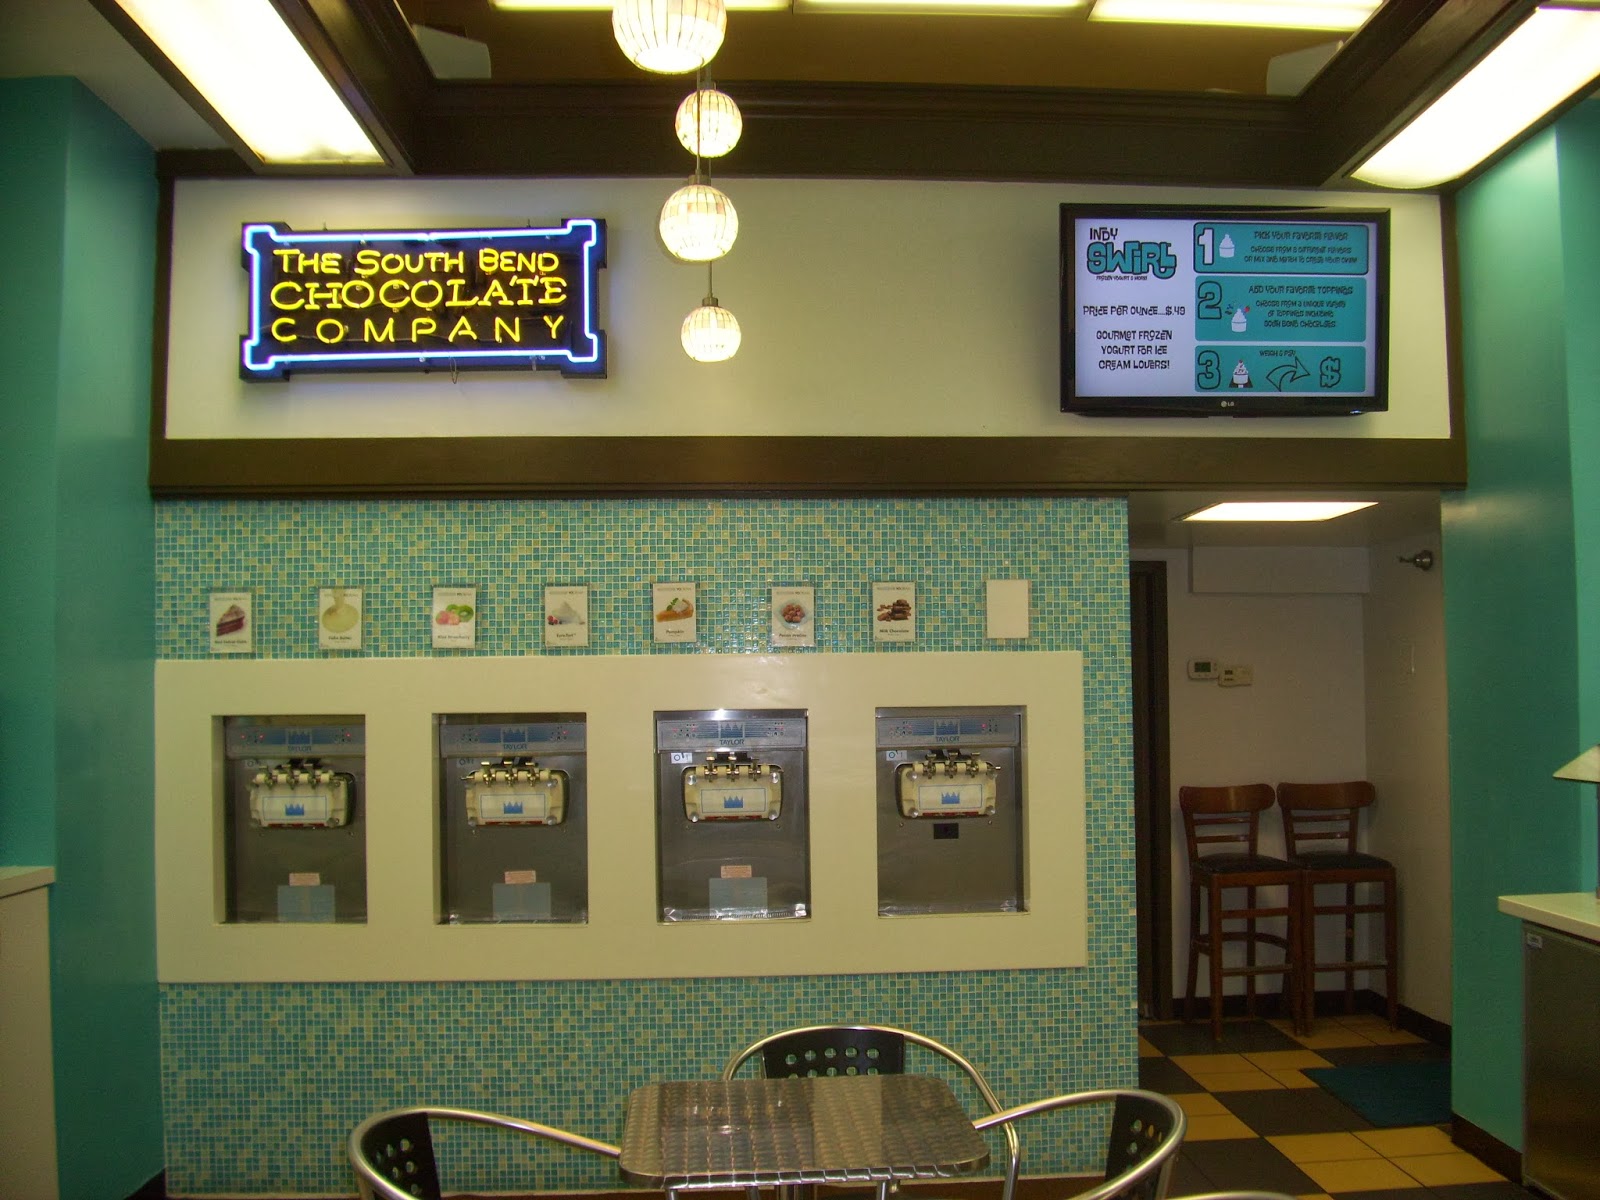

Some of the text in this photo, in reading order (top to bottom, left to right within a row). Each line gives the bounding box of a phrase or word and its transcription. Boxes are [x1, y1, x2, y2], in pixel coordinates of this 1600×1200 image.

[1089, 227, 1118, 241] INDY
[1272, 231, 1290, 240] YOUR
[1292, 231, 1321, 240] FAVORITE
[1198, 228, 1214, 265] 1
[272, 248, 559, 275] THE SOUTH BEND
[1087, 241, 1177, 279] SWIRL
[270, 276, 567, 311] CHOCOLATE
[1198, 281, 1222, 319] 2
[1249, 286, 1353, 295] ADD YOUR FAVORITE TOPPINGS
[1083, 305, 1109, 317] PRICE
[1110, 305, 1128, 316] PER
[271, 315, 565, 345] COMPANY
[1096, 330, 1173, 342] GOURMET FROZEN
[1101, 345, 1168, 355] YOGURT FOR ICE
[1098, 360, 1170, 371] CREAM LOVERS!
[1197, 351, 1221, 390] 3
